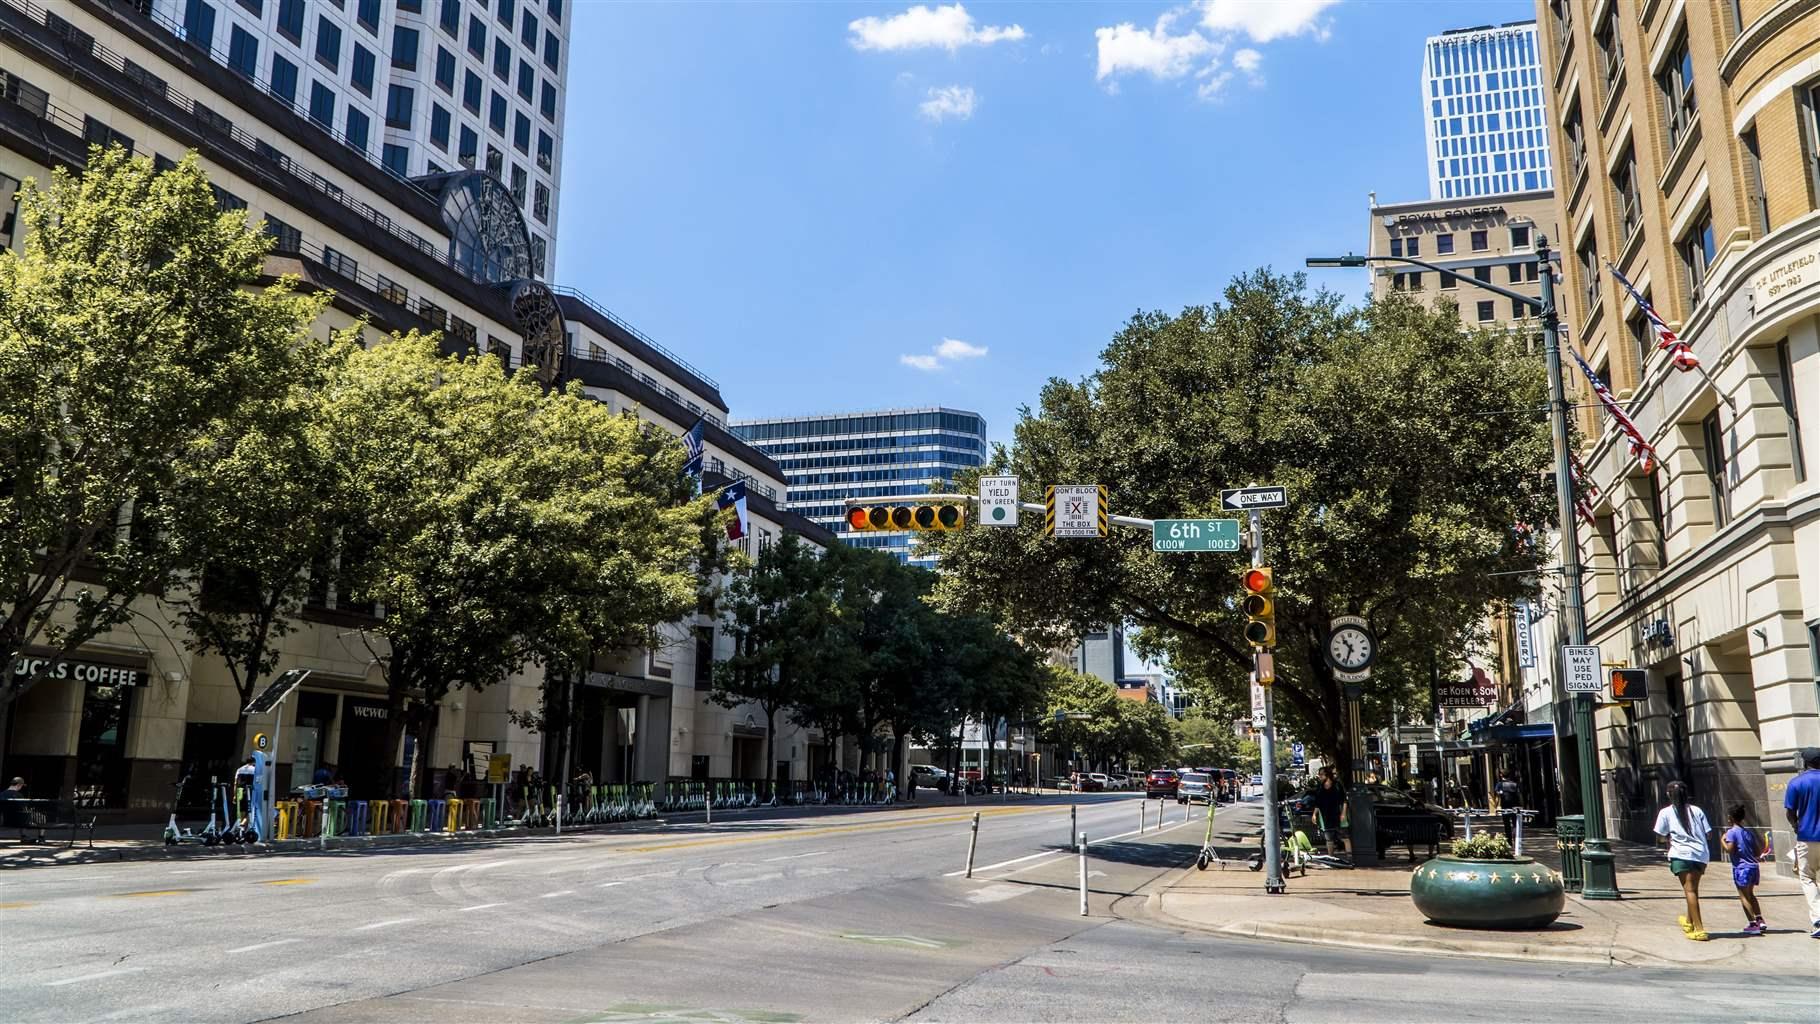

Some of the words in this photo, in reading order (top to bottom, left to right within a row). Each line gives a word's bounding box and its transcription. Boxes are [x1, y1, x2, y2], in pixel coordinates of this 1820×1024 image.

[1432, 36, 1468, 48] HYATT
[1471, 29, 1522, 44] CENTRIC
[1445, 206, 1507, 219] SONESTA
[1769, 254, 1815, 283] LITTLEFIELD
[988, 488, 1010, 497] YIELD
[1240, 494, 1258, 503] ONE
[1260, 492, 1279, 502] WAY
[1170, 522, 1200, 539] 6th
[1207, 522, 1223, 532] ST
[1162, 540, 1185, 549] 100W
[1208, 540, 1230, 549] 100E
[74, 664, 137, 686] COFFEE
[1575, 673, 1592, 681] PED
[1450, 687, 1470, 696] KOEN
[1472, 688, 1479, 696] &
[1480, 686, 1497, 696] SON
[1443, 697, 1485, 705] JEWELERS
[260, 737, 266, 747] B
